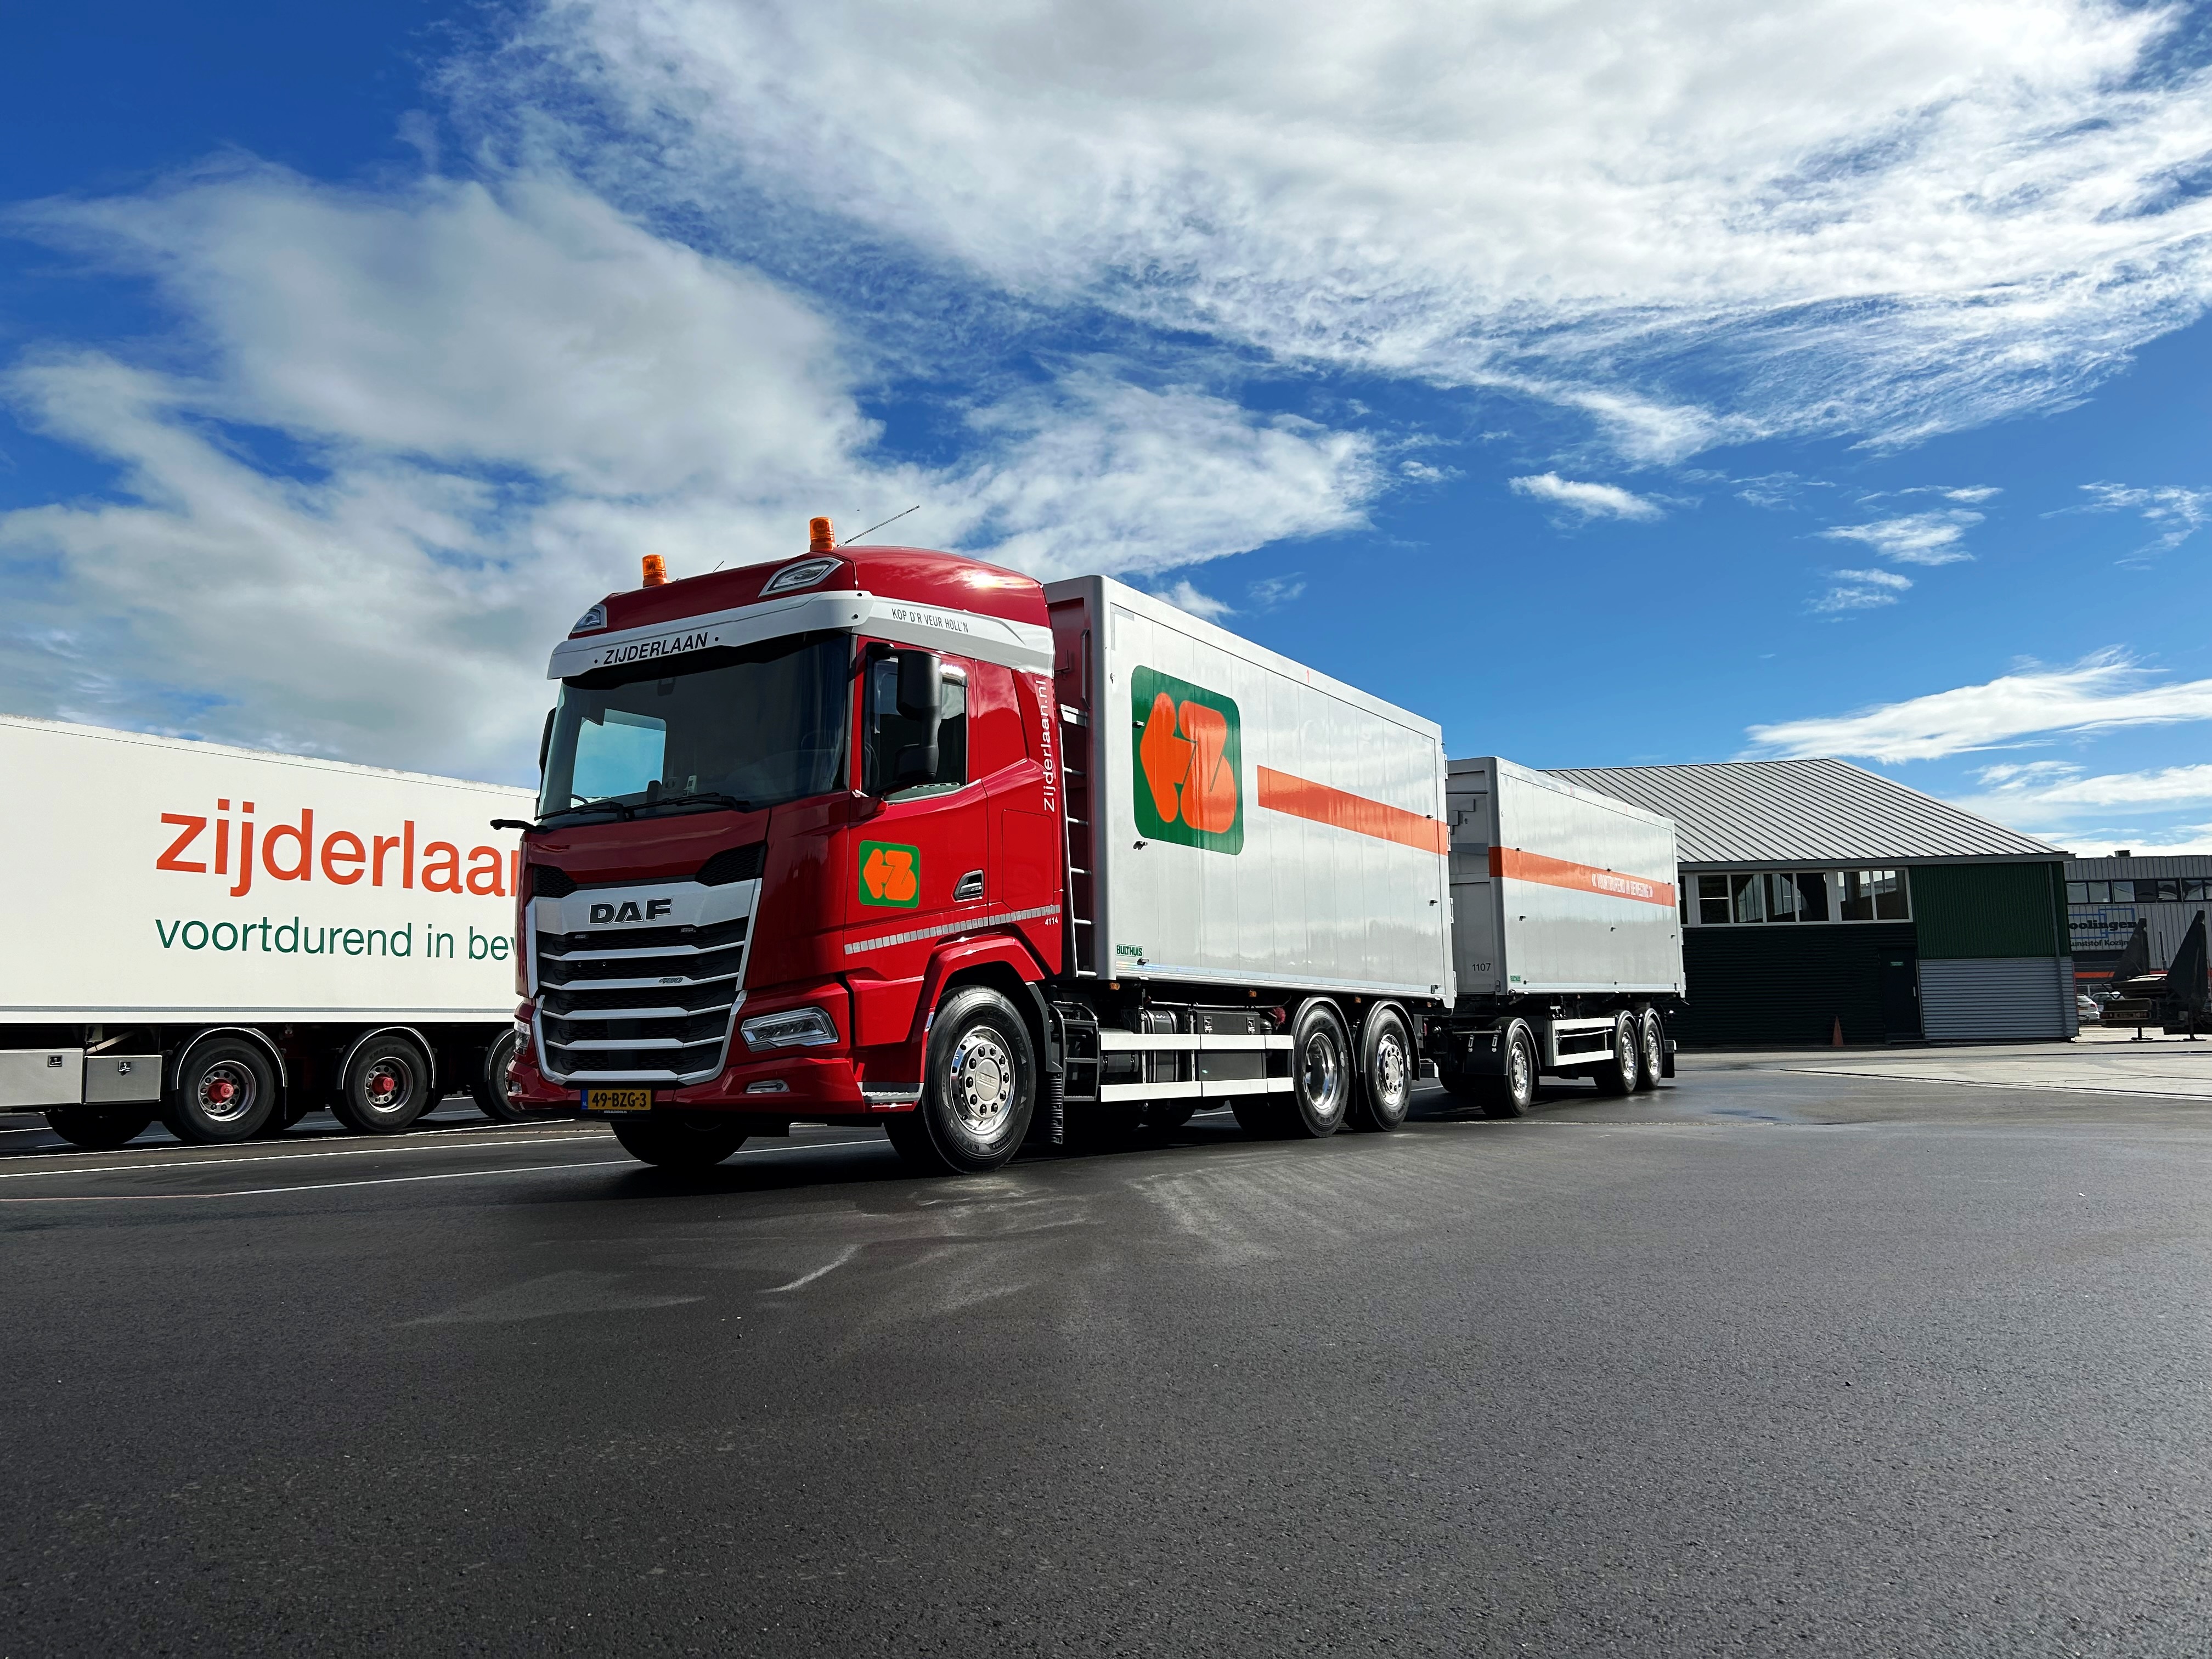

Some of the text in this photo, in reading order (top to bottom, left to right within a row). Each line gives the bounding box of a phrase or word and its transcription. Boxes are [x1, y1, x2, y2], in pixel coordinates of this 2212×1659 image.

[891, 608, 907, 620] KOP
[923, 613, 943, 628] VEUR
[603, 631, 708, 665] ZIJDERLAAN
[1035, 680, 1056, 812] Zijderlaan.nl
[588, 898, 673, 925] DAF
[1045, 916, 1058, 926] 4114
[155, 916, 412, 958] voortdurend
[427, 924, 454, 959] in
[1116, 945, 1143, 957] BULTHUIS
[1472, 963, 1491, 972] 1107
[592, 1092, 647, 1108] 49-BZG-3
